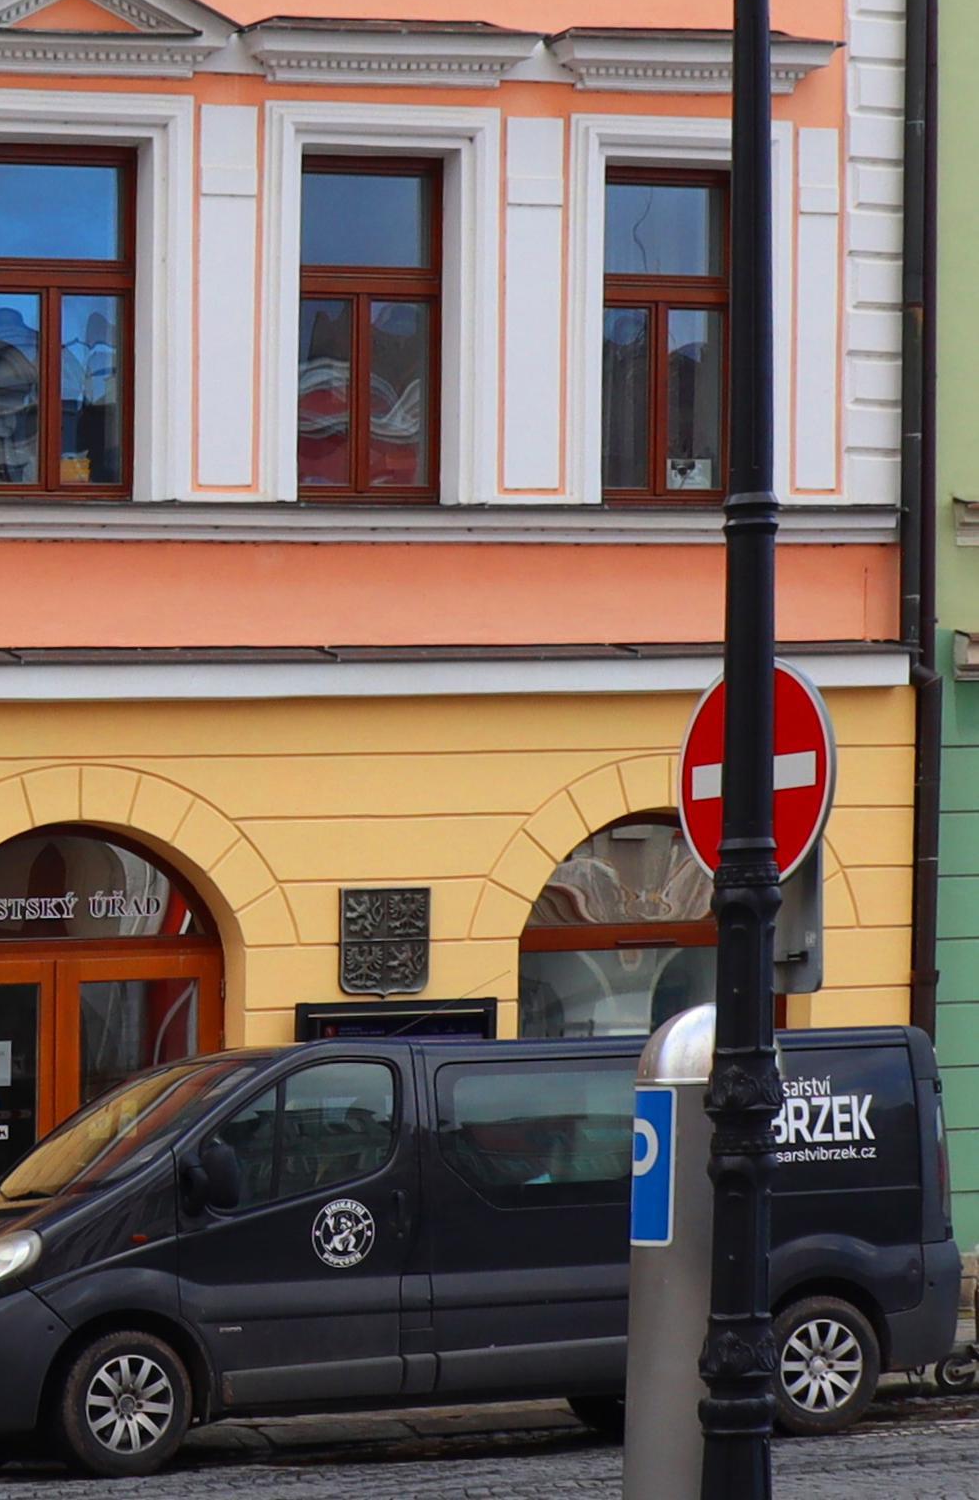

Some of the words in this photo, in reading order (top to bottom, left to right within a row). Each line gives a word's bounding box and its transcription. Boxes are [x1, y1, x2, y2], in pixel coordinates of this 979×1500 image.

[88, 890, 161, 919] ÚŘAD
[782, 1075, 831, 1097] sařství
[776, 1145, 877, 1164] sarstvibrzek.cz
